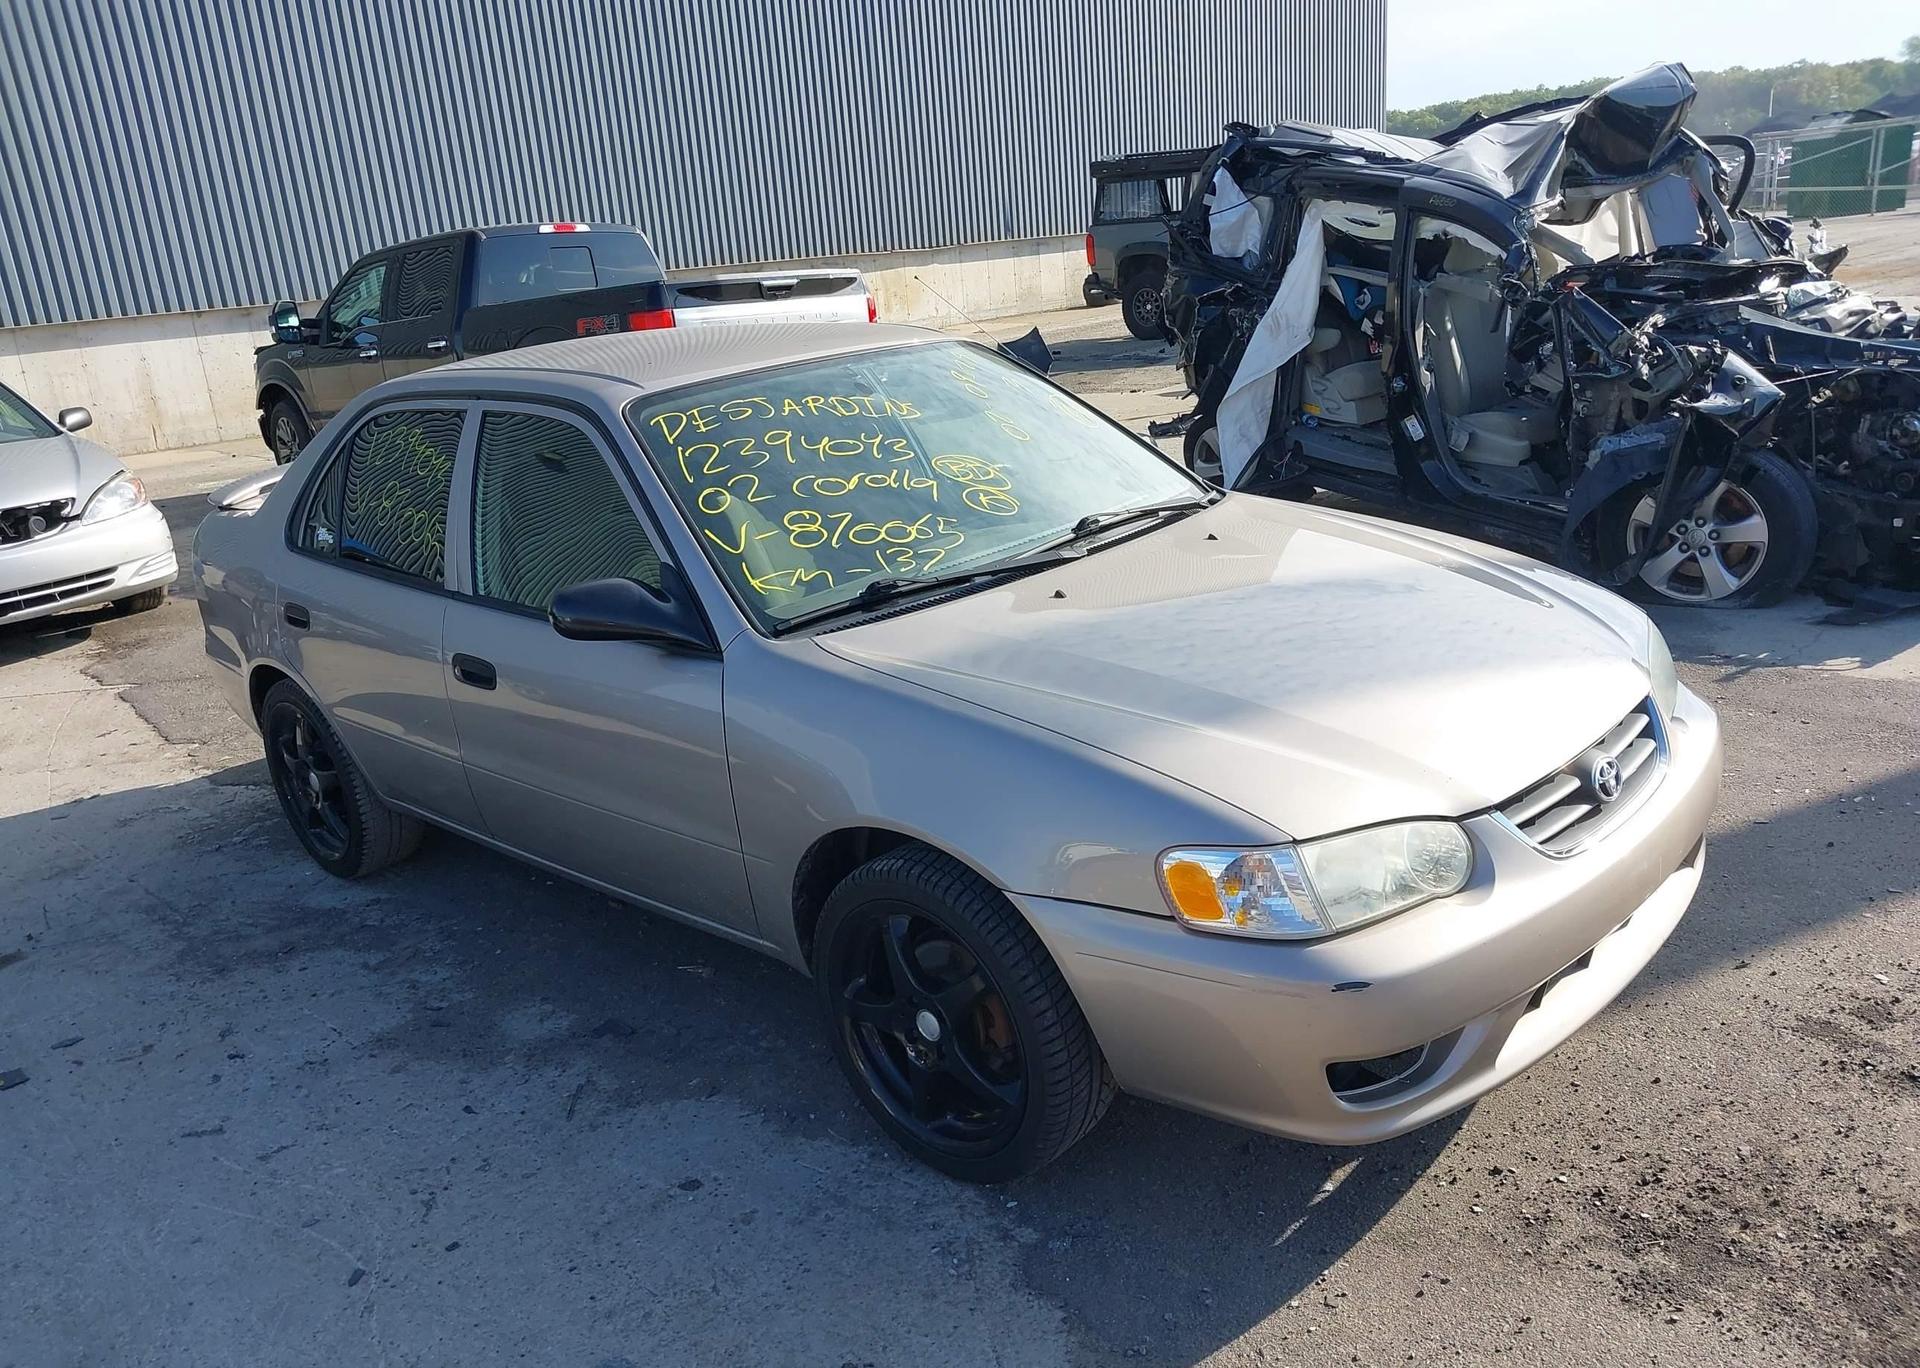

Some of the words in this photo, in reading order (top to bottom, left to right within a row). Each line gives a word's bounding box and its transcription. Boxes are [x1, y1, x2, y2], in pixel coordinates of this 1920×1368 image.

[576, 313, 620, 337] FX4
[650, 396, 921, 444] DESJARDINS
[677, 424, 915, 482] 12394043
[698, 474, 776, 514] 02
